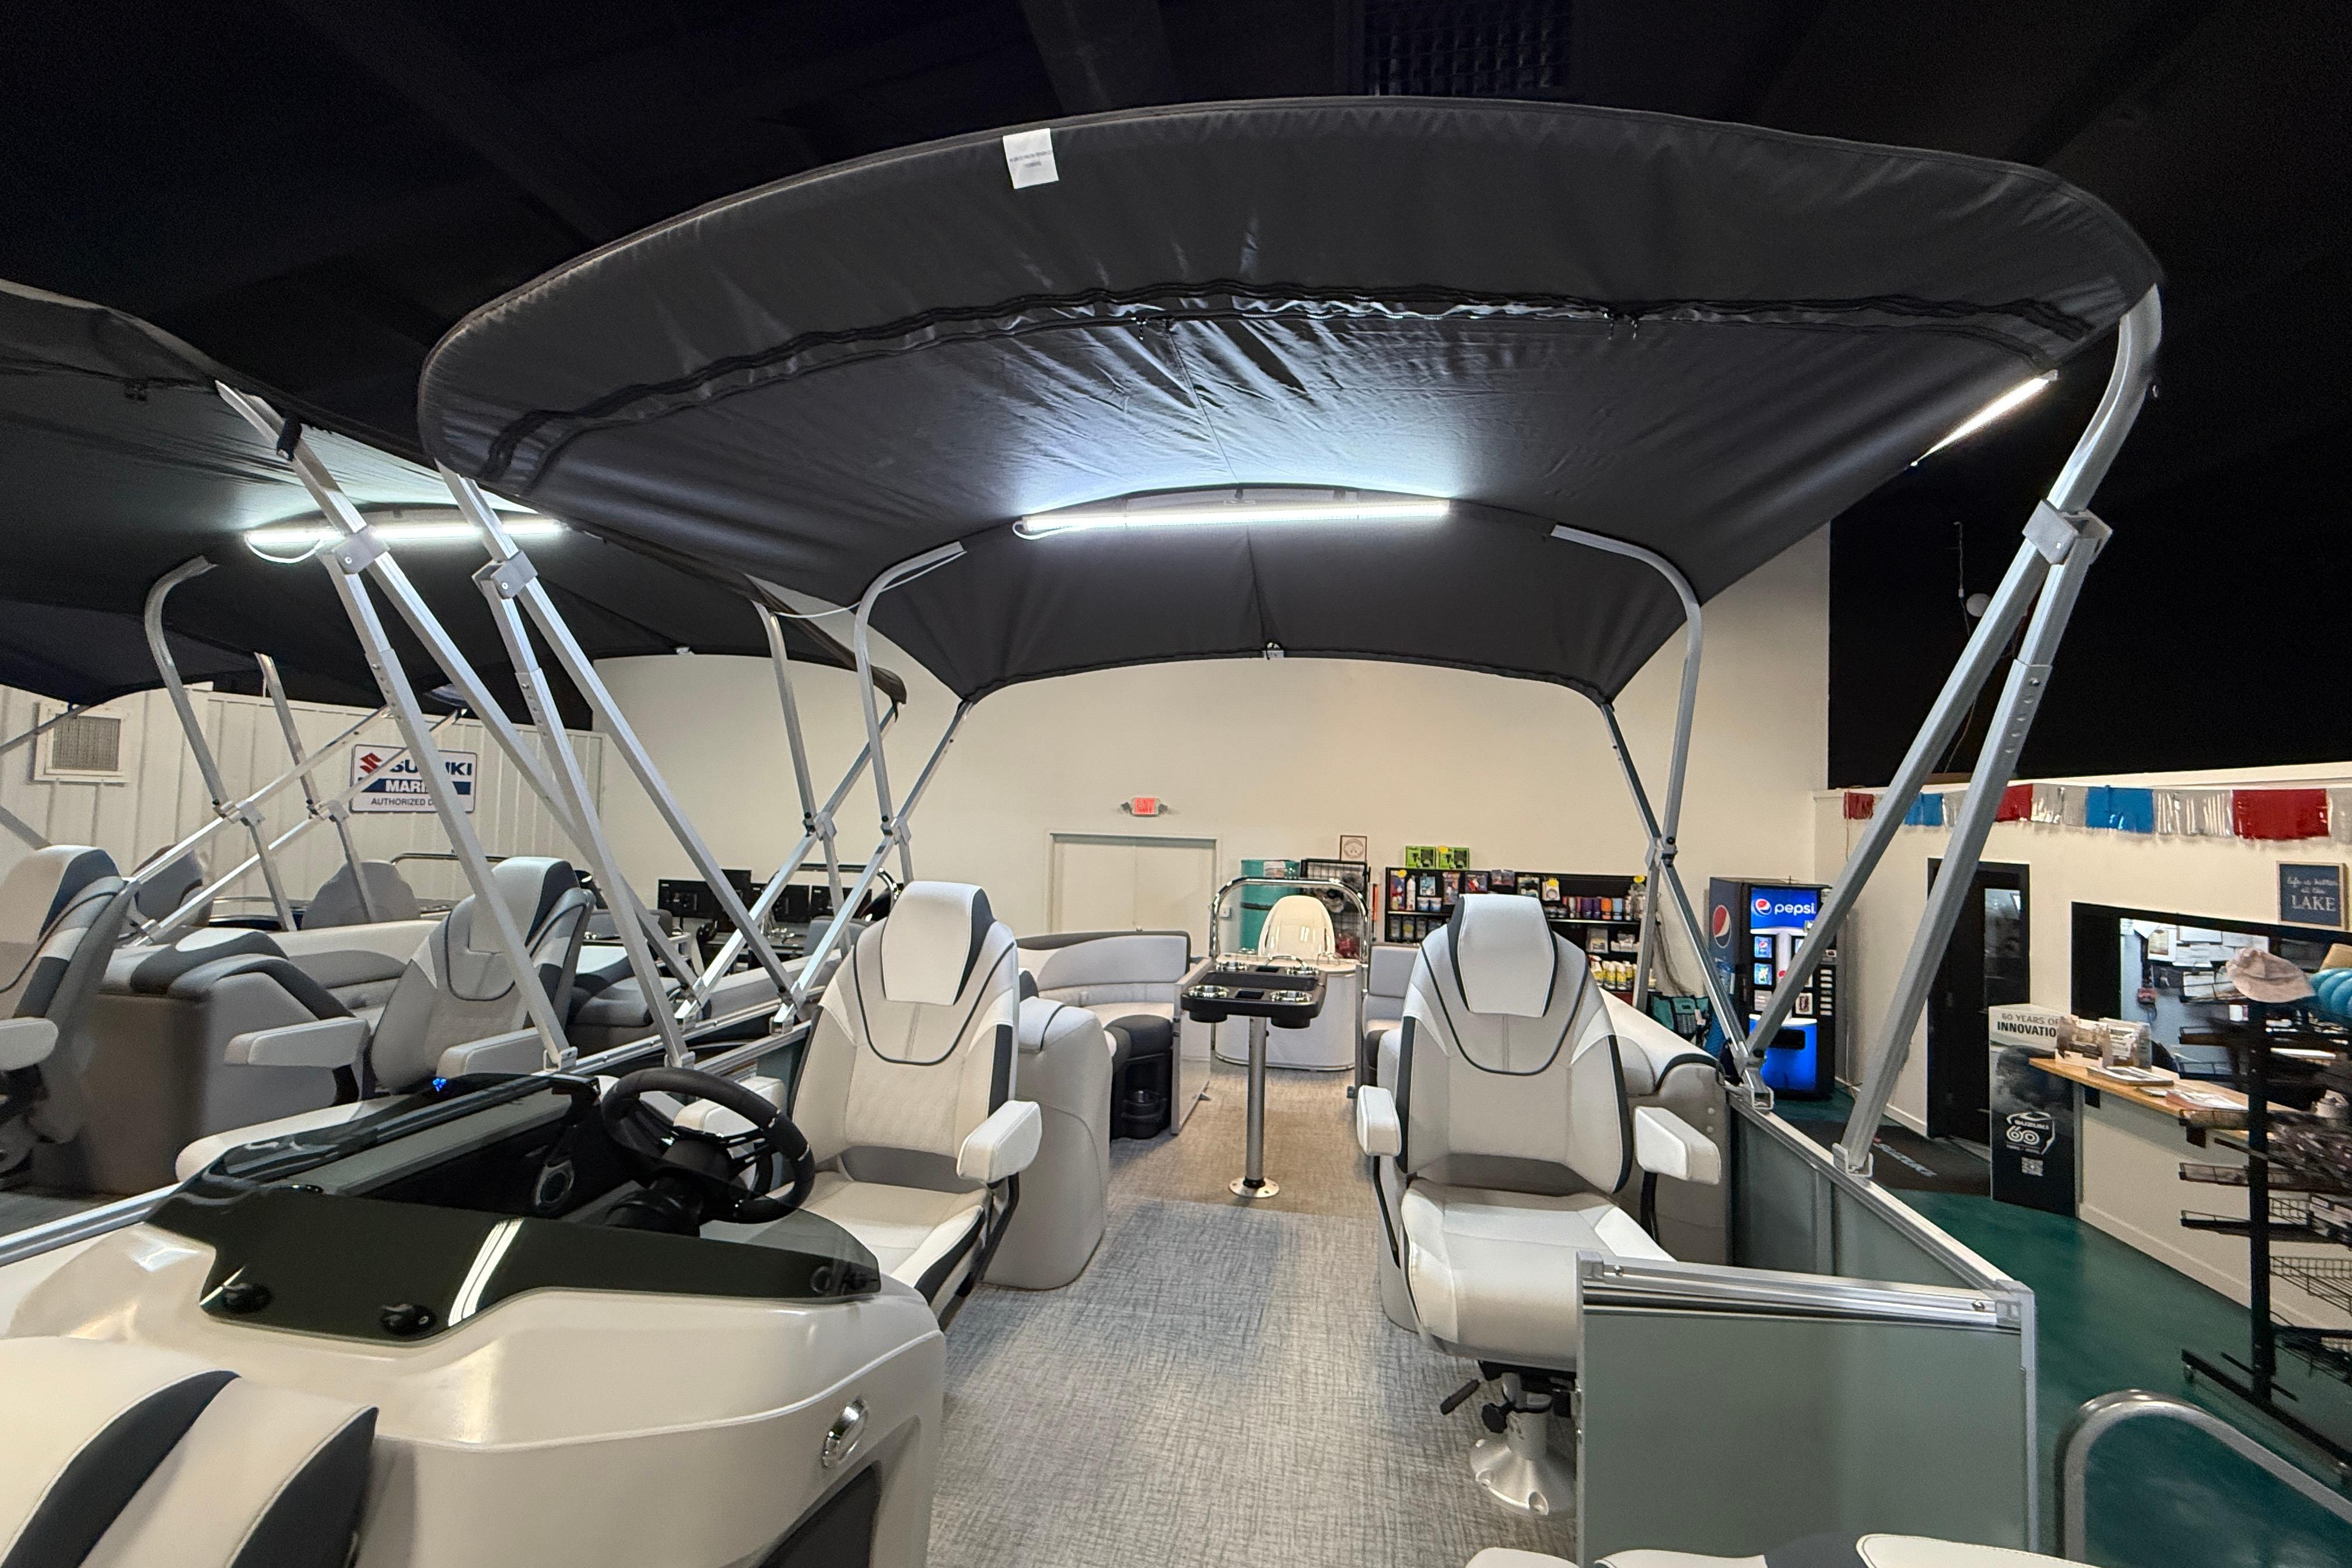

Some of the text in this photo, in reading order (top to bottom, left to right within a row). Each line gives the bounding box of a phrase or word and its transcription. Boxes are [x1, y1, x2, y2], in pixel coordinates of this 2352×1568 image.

[390, 759, 473, 776] SUKI
[385, 779, 429, 793] MARI
[371, 797, 426, 806] AUTHORIZED
[1774, 902, 1817, 916] pepsi
[2291, 895, 2337, 912] LAKE
[2015, 1014, 2045, 1024] YEARS
[1997, 1021, 2057, 1037] INNOVATIO
[2006, 1125, 2040, 1144] 60
